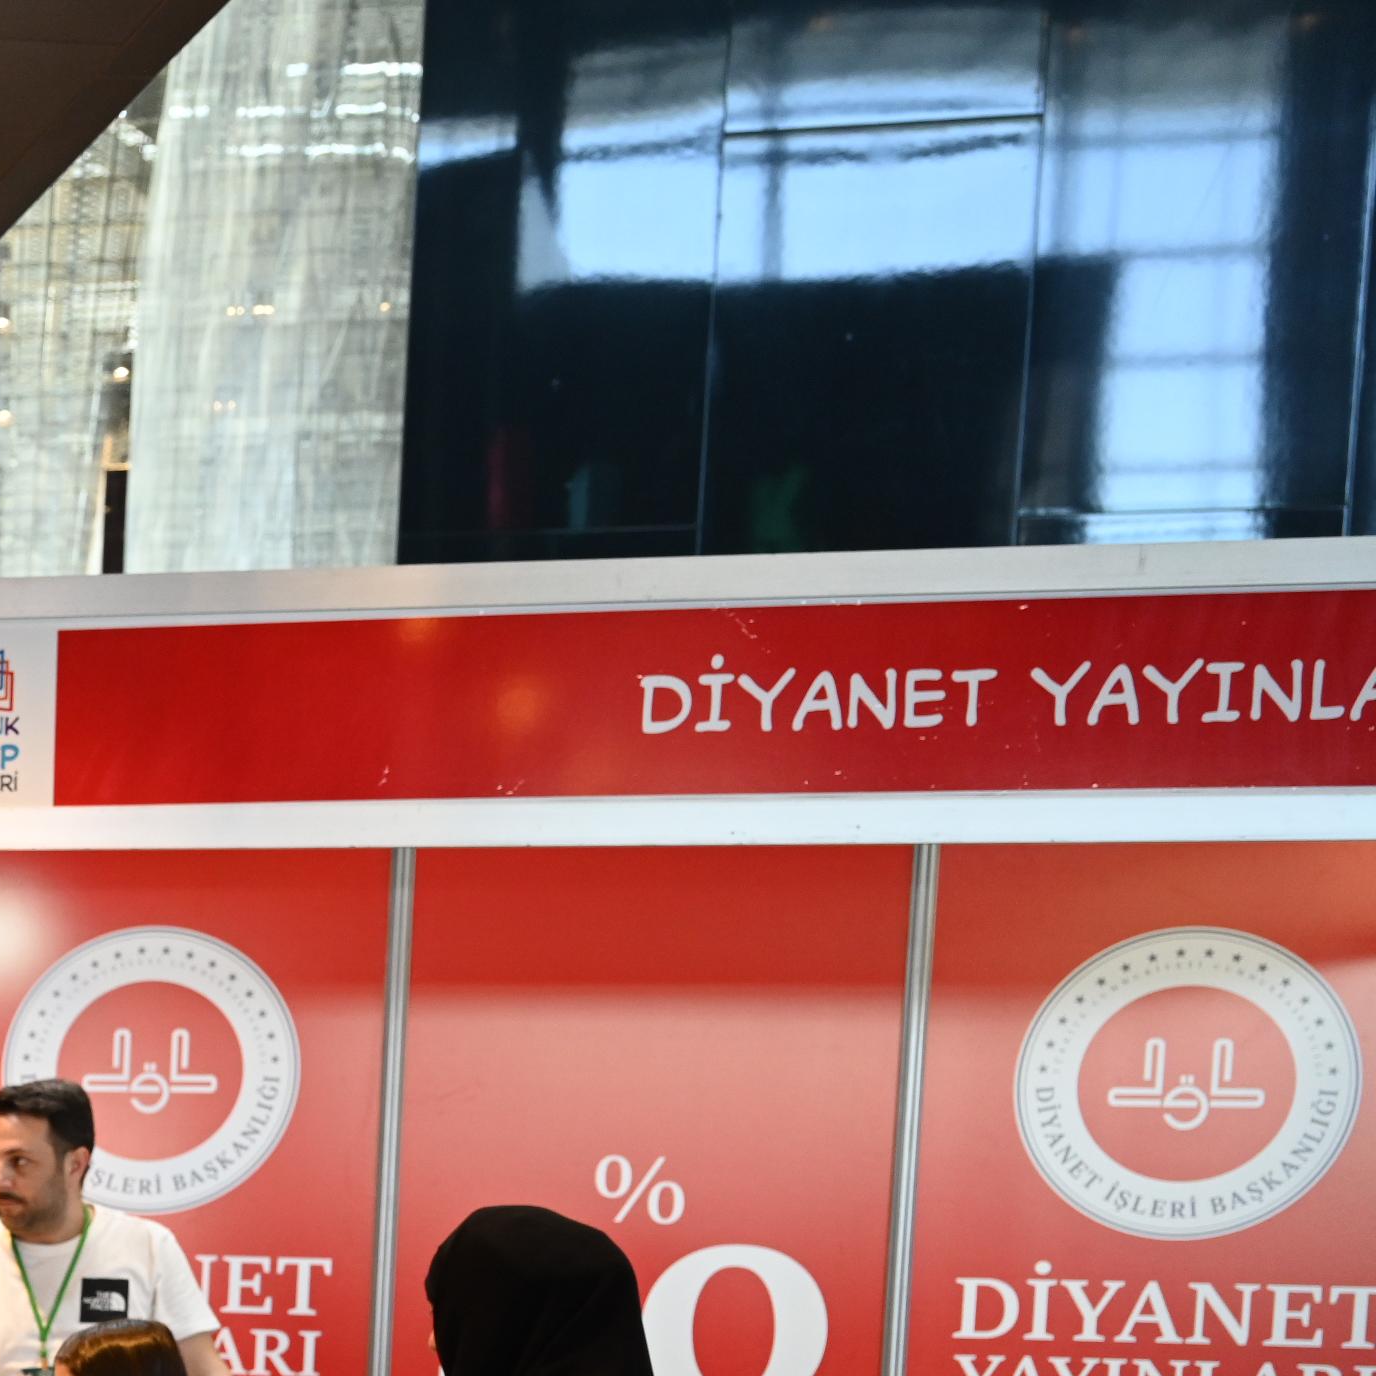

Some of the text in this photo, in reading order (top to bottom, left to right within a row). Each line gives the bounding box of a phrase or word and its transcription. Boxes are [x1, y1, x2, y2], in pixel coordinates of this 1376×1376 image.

[637, 653, 998, 735] DİYANET
[90, 1075, 281, 1196] ŞLERİ BAŞKANLIĞI
[1035, 1086, 1339, 1218] DİYANET İŞLERİ BAŞKANLIĞI
[594, 1154, 686, 1225] %
[952, 1260, 1376, 1349] DİYANET
